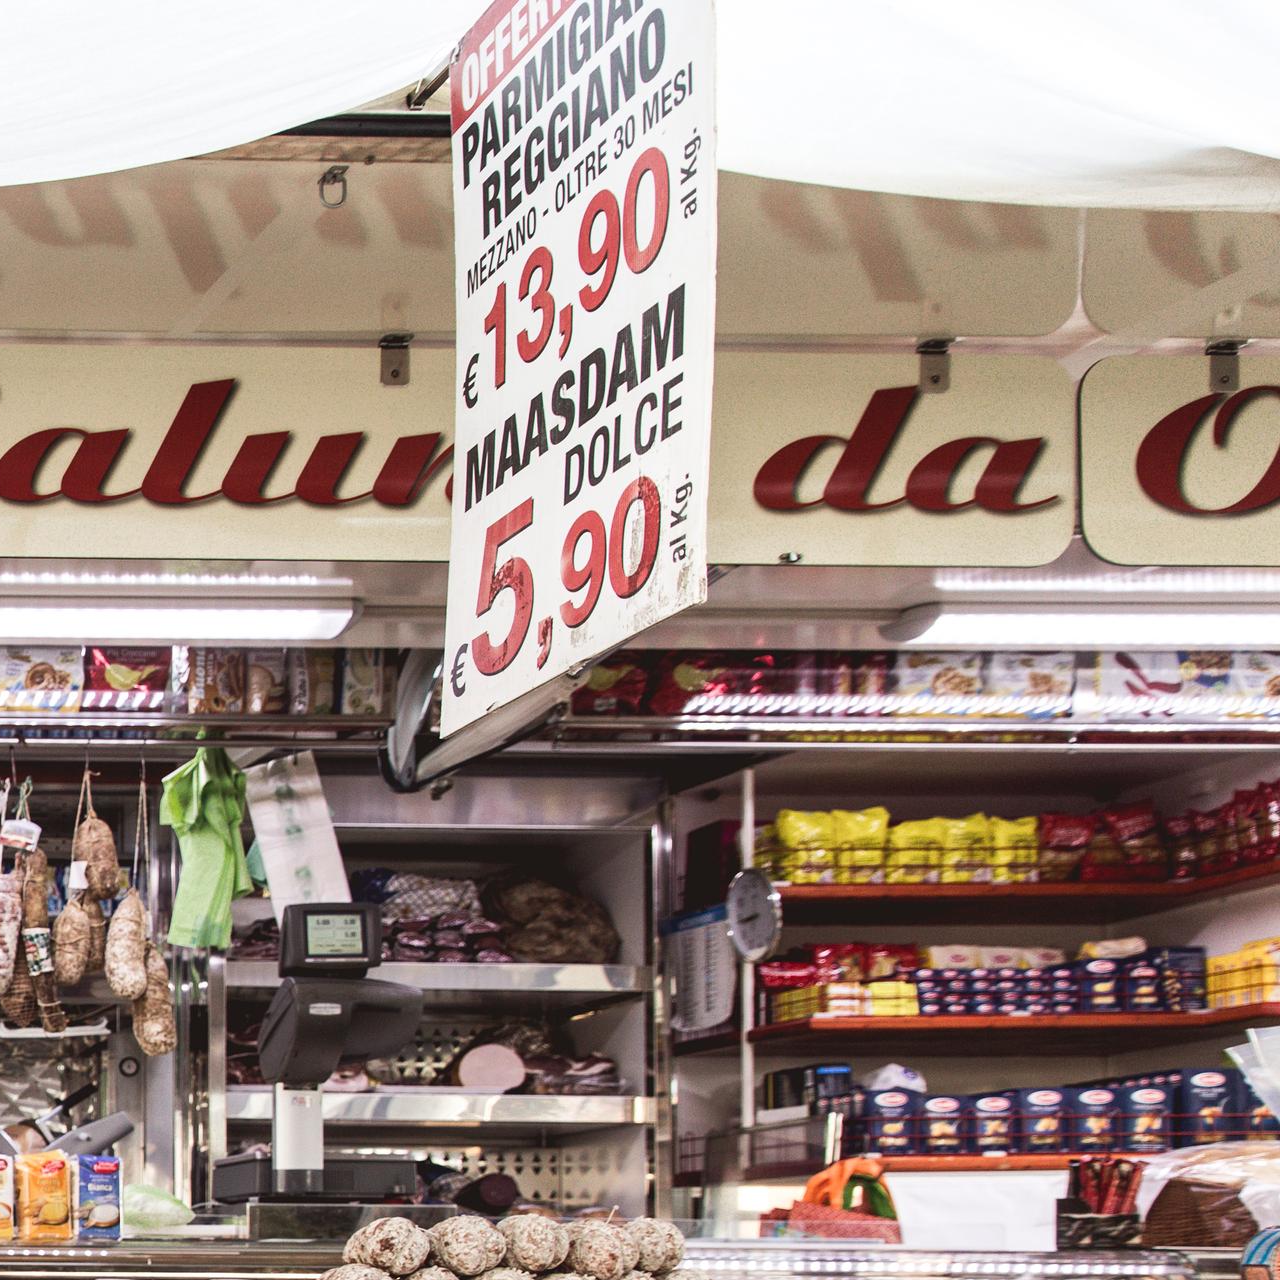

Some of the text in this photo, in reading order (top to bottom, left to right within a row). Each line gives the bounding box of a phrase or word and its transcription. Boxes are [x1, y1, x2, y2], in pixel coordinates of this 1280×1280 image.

[467, 62, 693, 298] MEZZANO OLTRE 30 MESI
[483, 8, 666, 240] REGGIANO
[463, 147, 698, 408] € 13,90 al
[464, 283, 686, 513] MAASDAM
[563, 372, 684, 506] DOLCE
[753, 385, 1061, 515] da
[450, 476, 688, 698] € 5,90 al
